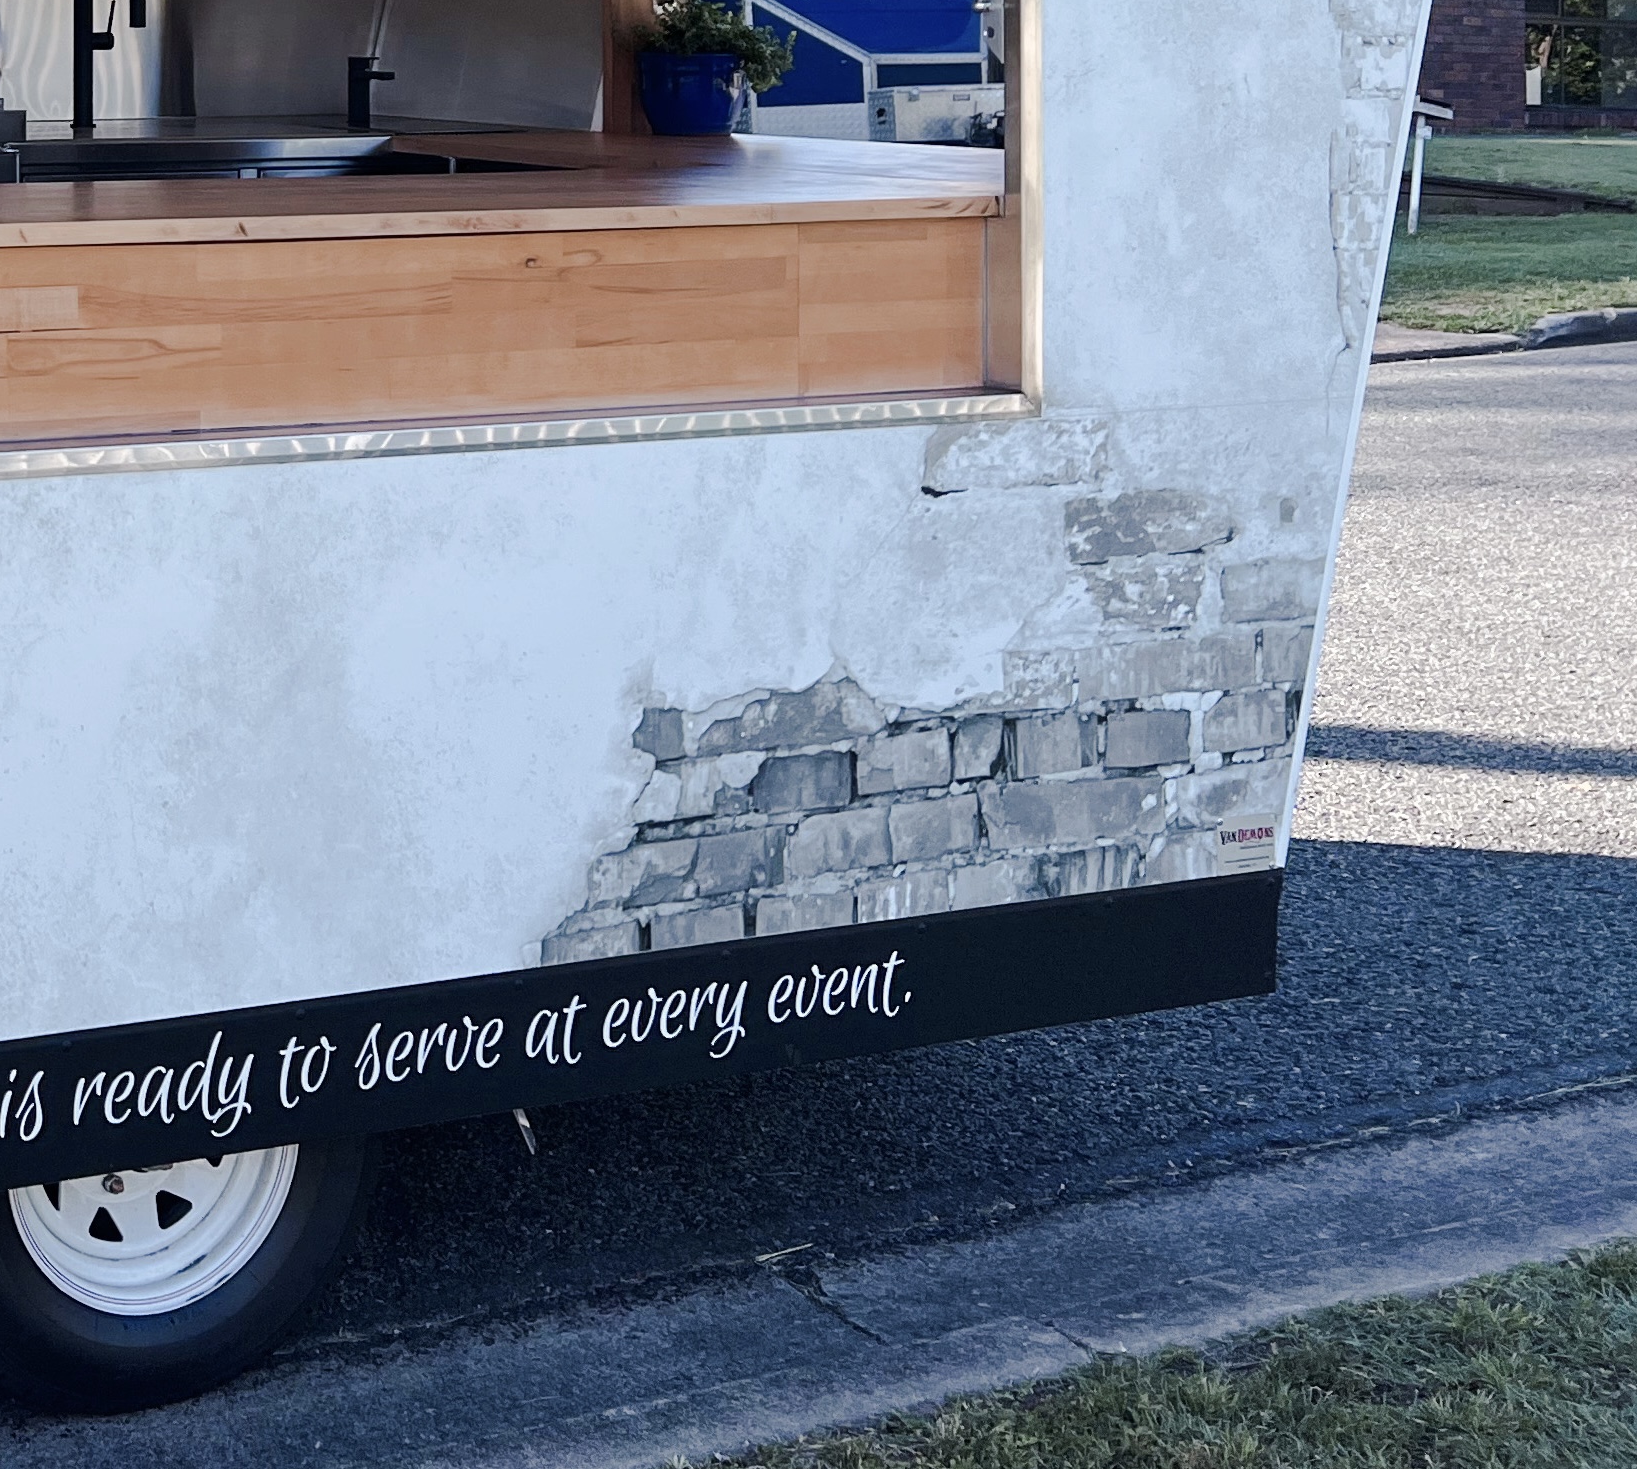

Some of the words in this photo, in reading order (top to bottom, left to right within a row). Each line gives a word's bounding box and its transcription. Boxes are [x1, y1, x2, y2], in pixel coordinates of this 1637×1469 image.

[0, 1067, 45, 1142] is
[73, 1030, 255, 1138] ready
[279, 1035, 337, 1109] to
[354, 1015, 504, 1090] serve
[525, 994, 587, 1065] at
[602, 980, 748, 1059] every
[767, 950, 913, 1023] event.
